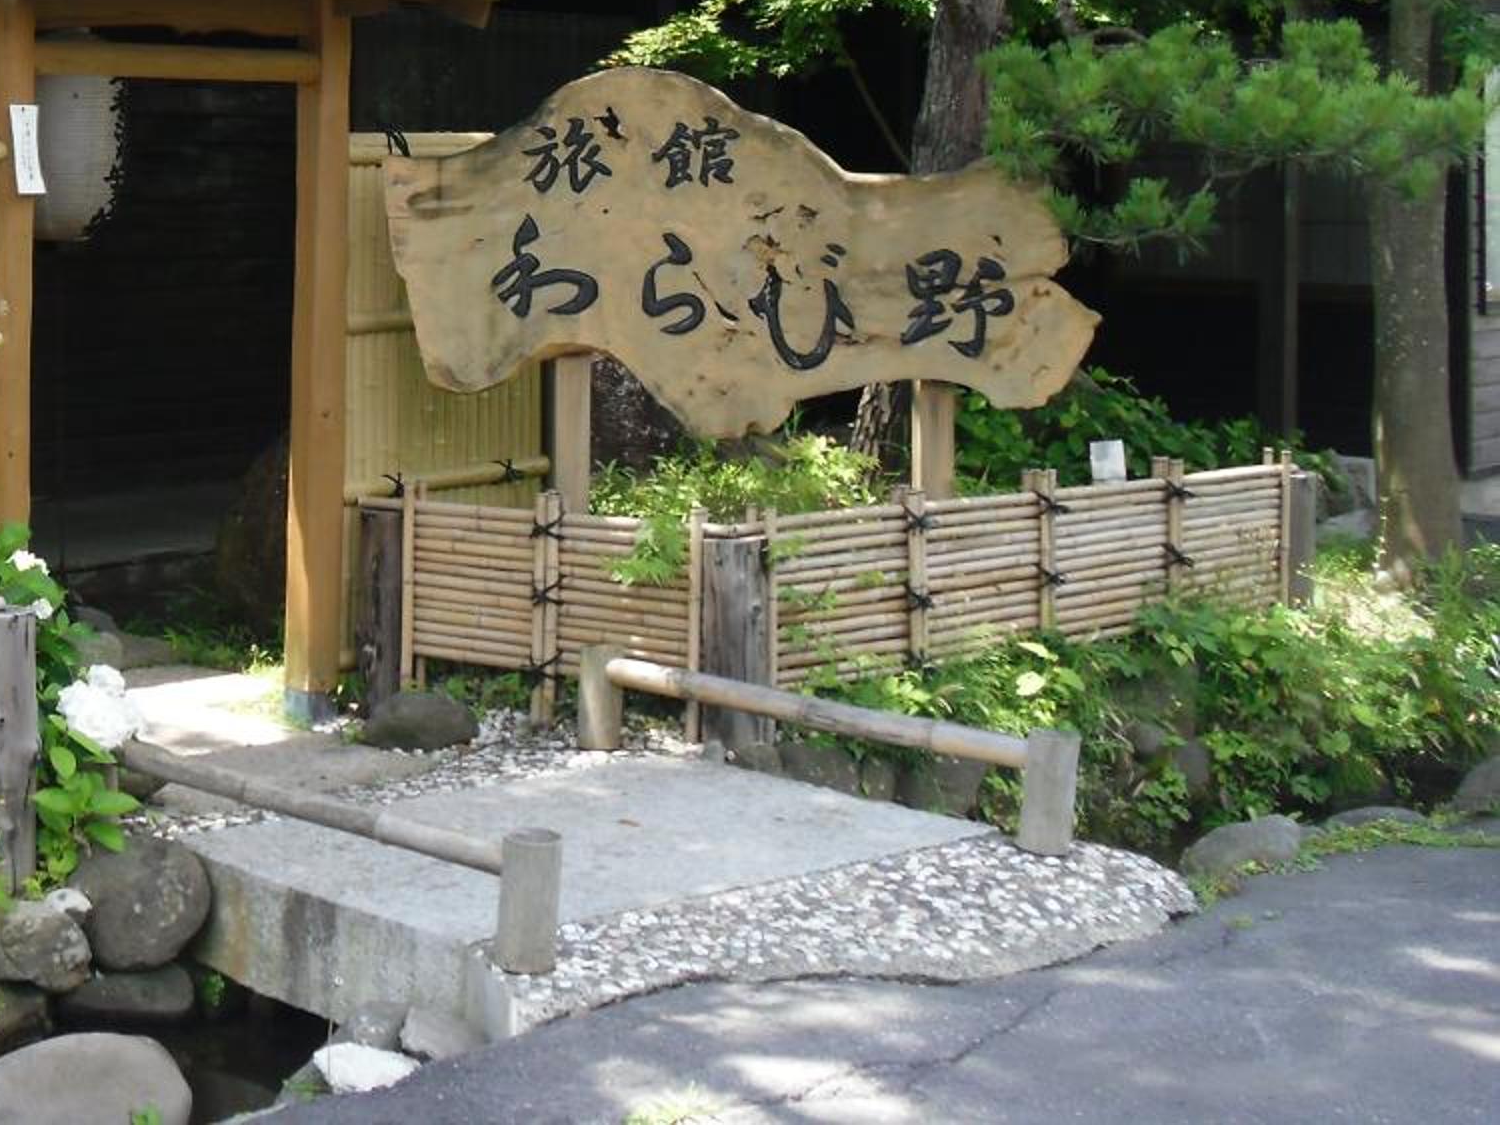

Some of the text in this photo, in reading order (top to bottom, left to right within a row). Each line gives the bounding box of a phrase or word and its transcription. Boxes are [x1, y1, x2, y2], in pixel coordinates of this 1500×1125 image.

[522, 117, 741, 193] 旅館
[492, 213, 1014, 370] わらび野
